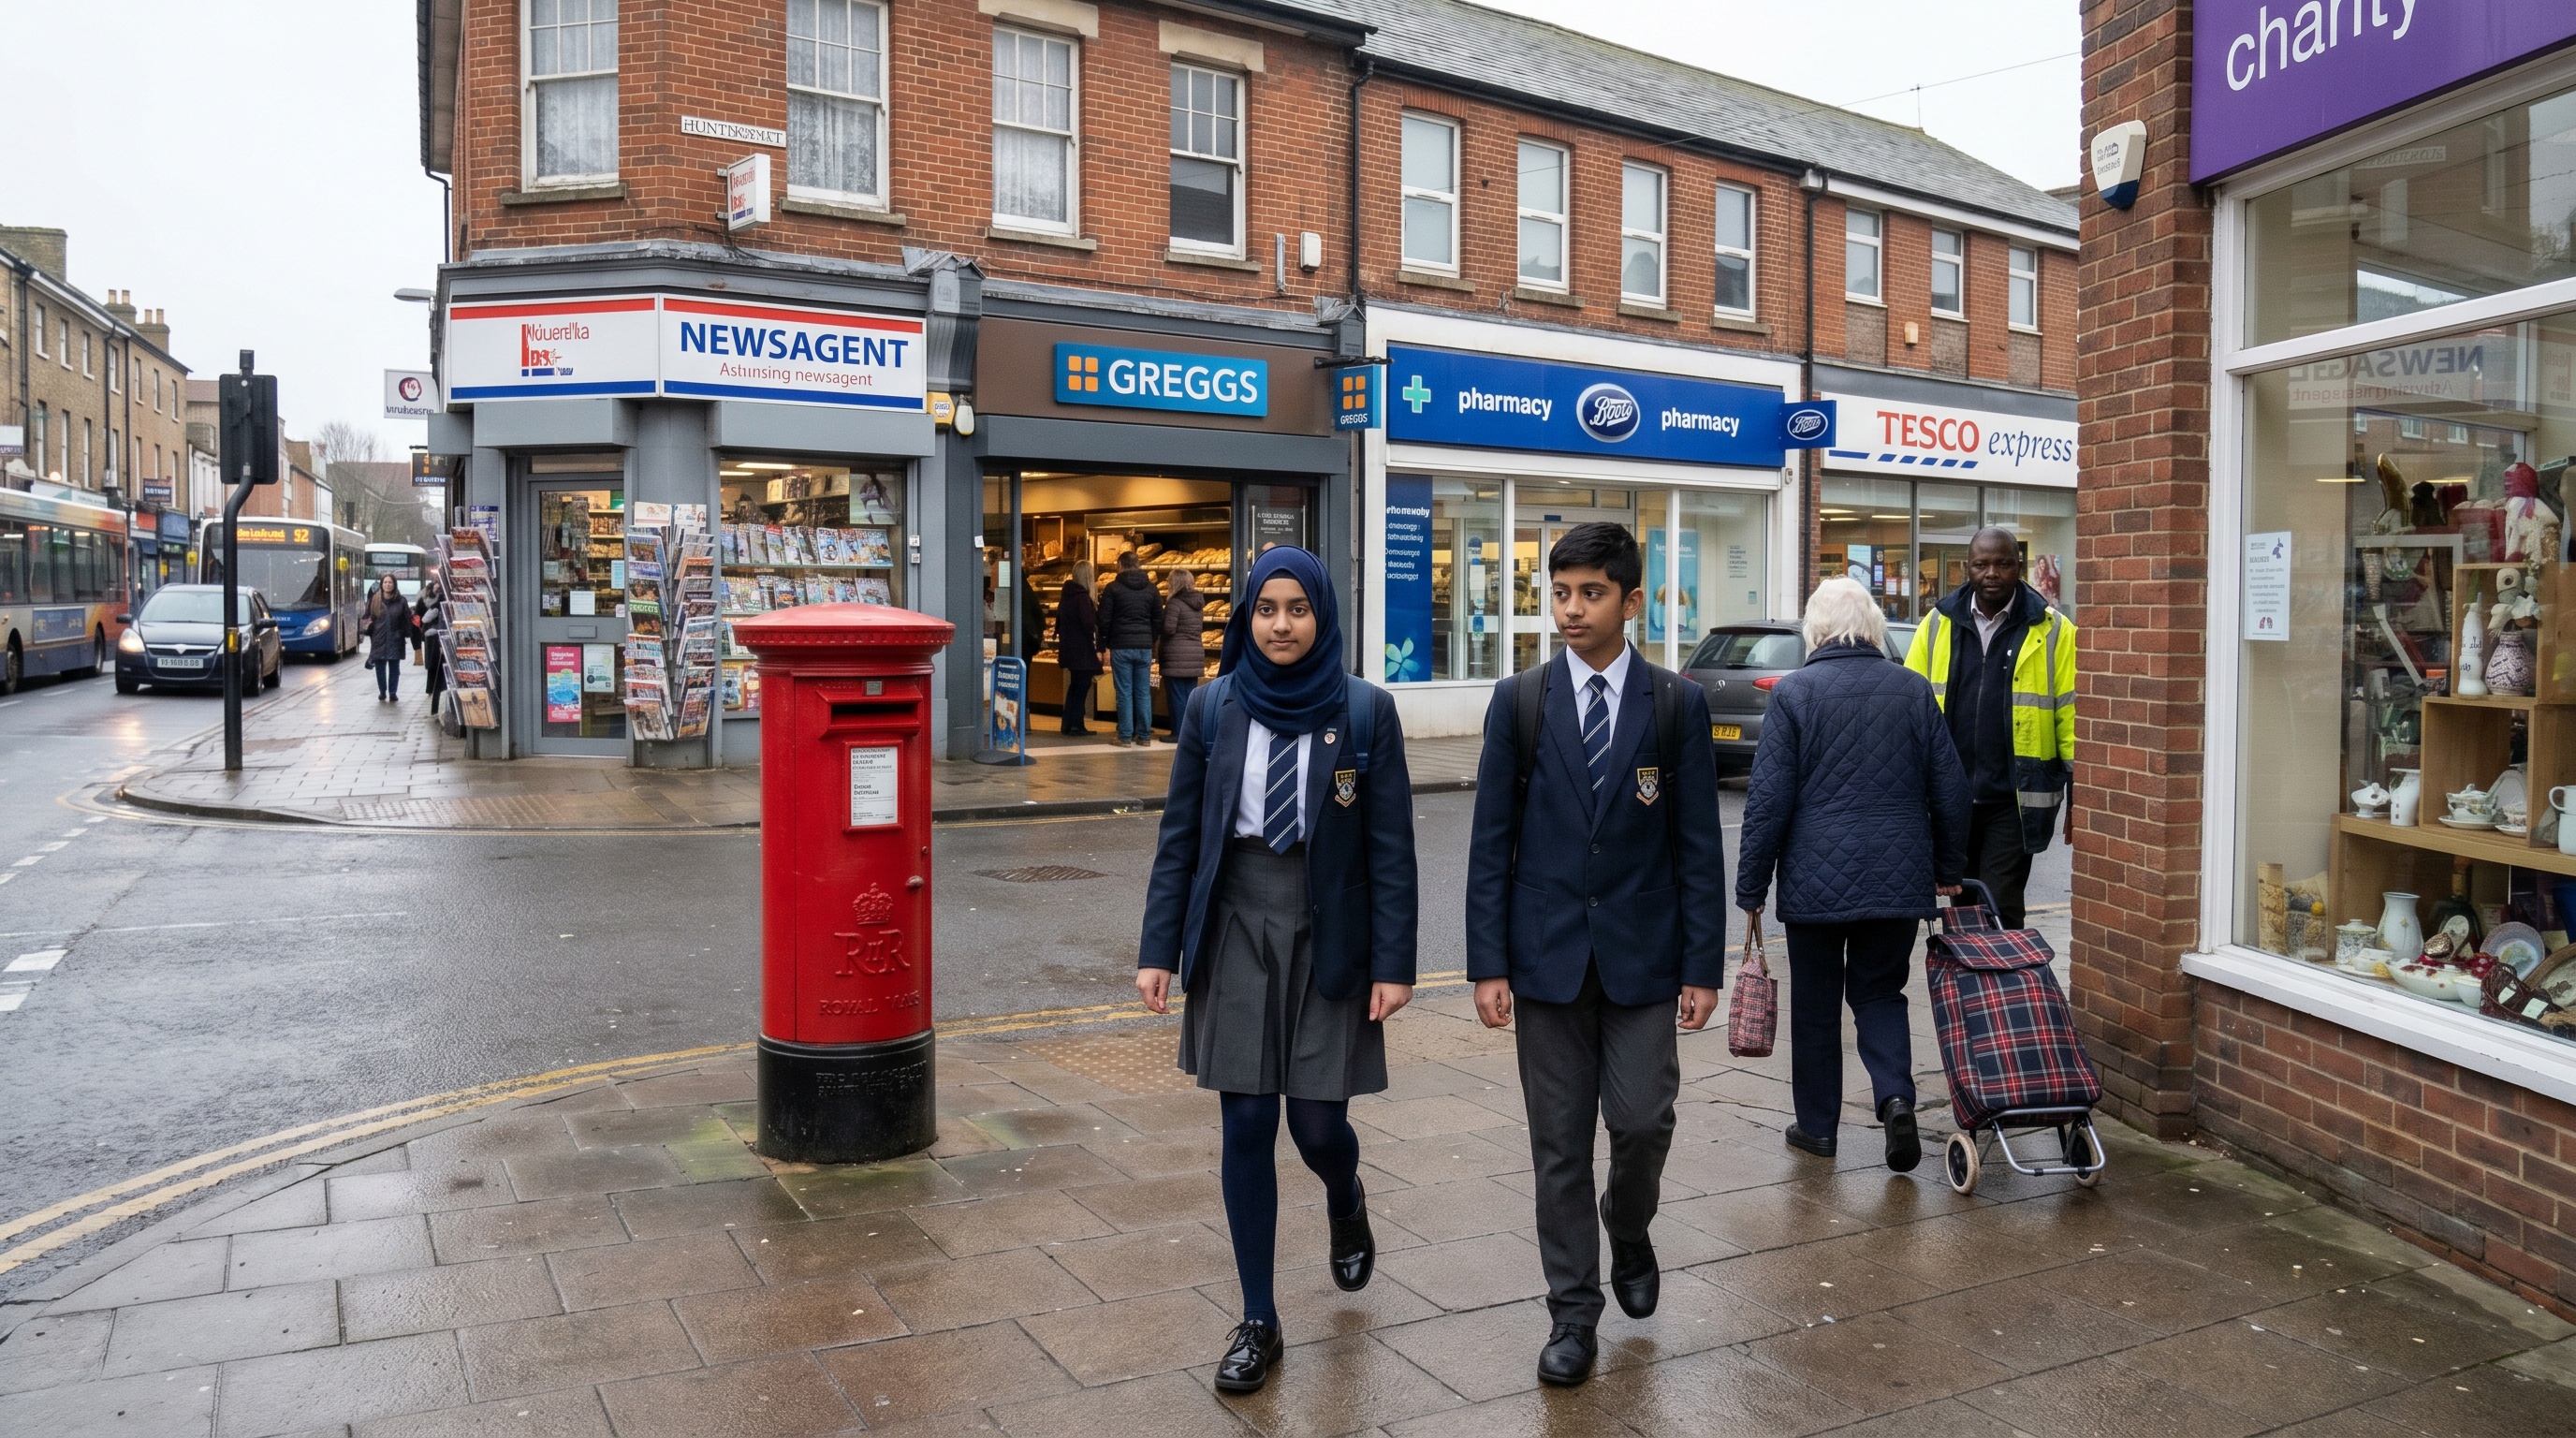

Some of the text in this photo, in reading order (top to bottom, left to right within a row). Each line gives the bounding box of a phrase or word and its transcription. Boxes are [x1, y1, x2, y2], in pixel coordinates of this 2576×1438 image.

[681, 321, 909, 369] NEWSAGENT
[796, 370, 873, 389] newsagent
[1108, 359, 1259, 404] GREGGS
[1458, 387, 1553, 421] pharmacy
[1661, 406, 1740, 438] pharmacy
[1877, 410, 2072, 467] TESCO express
[819, 1000, 878, 1015] ROYAL
